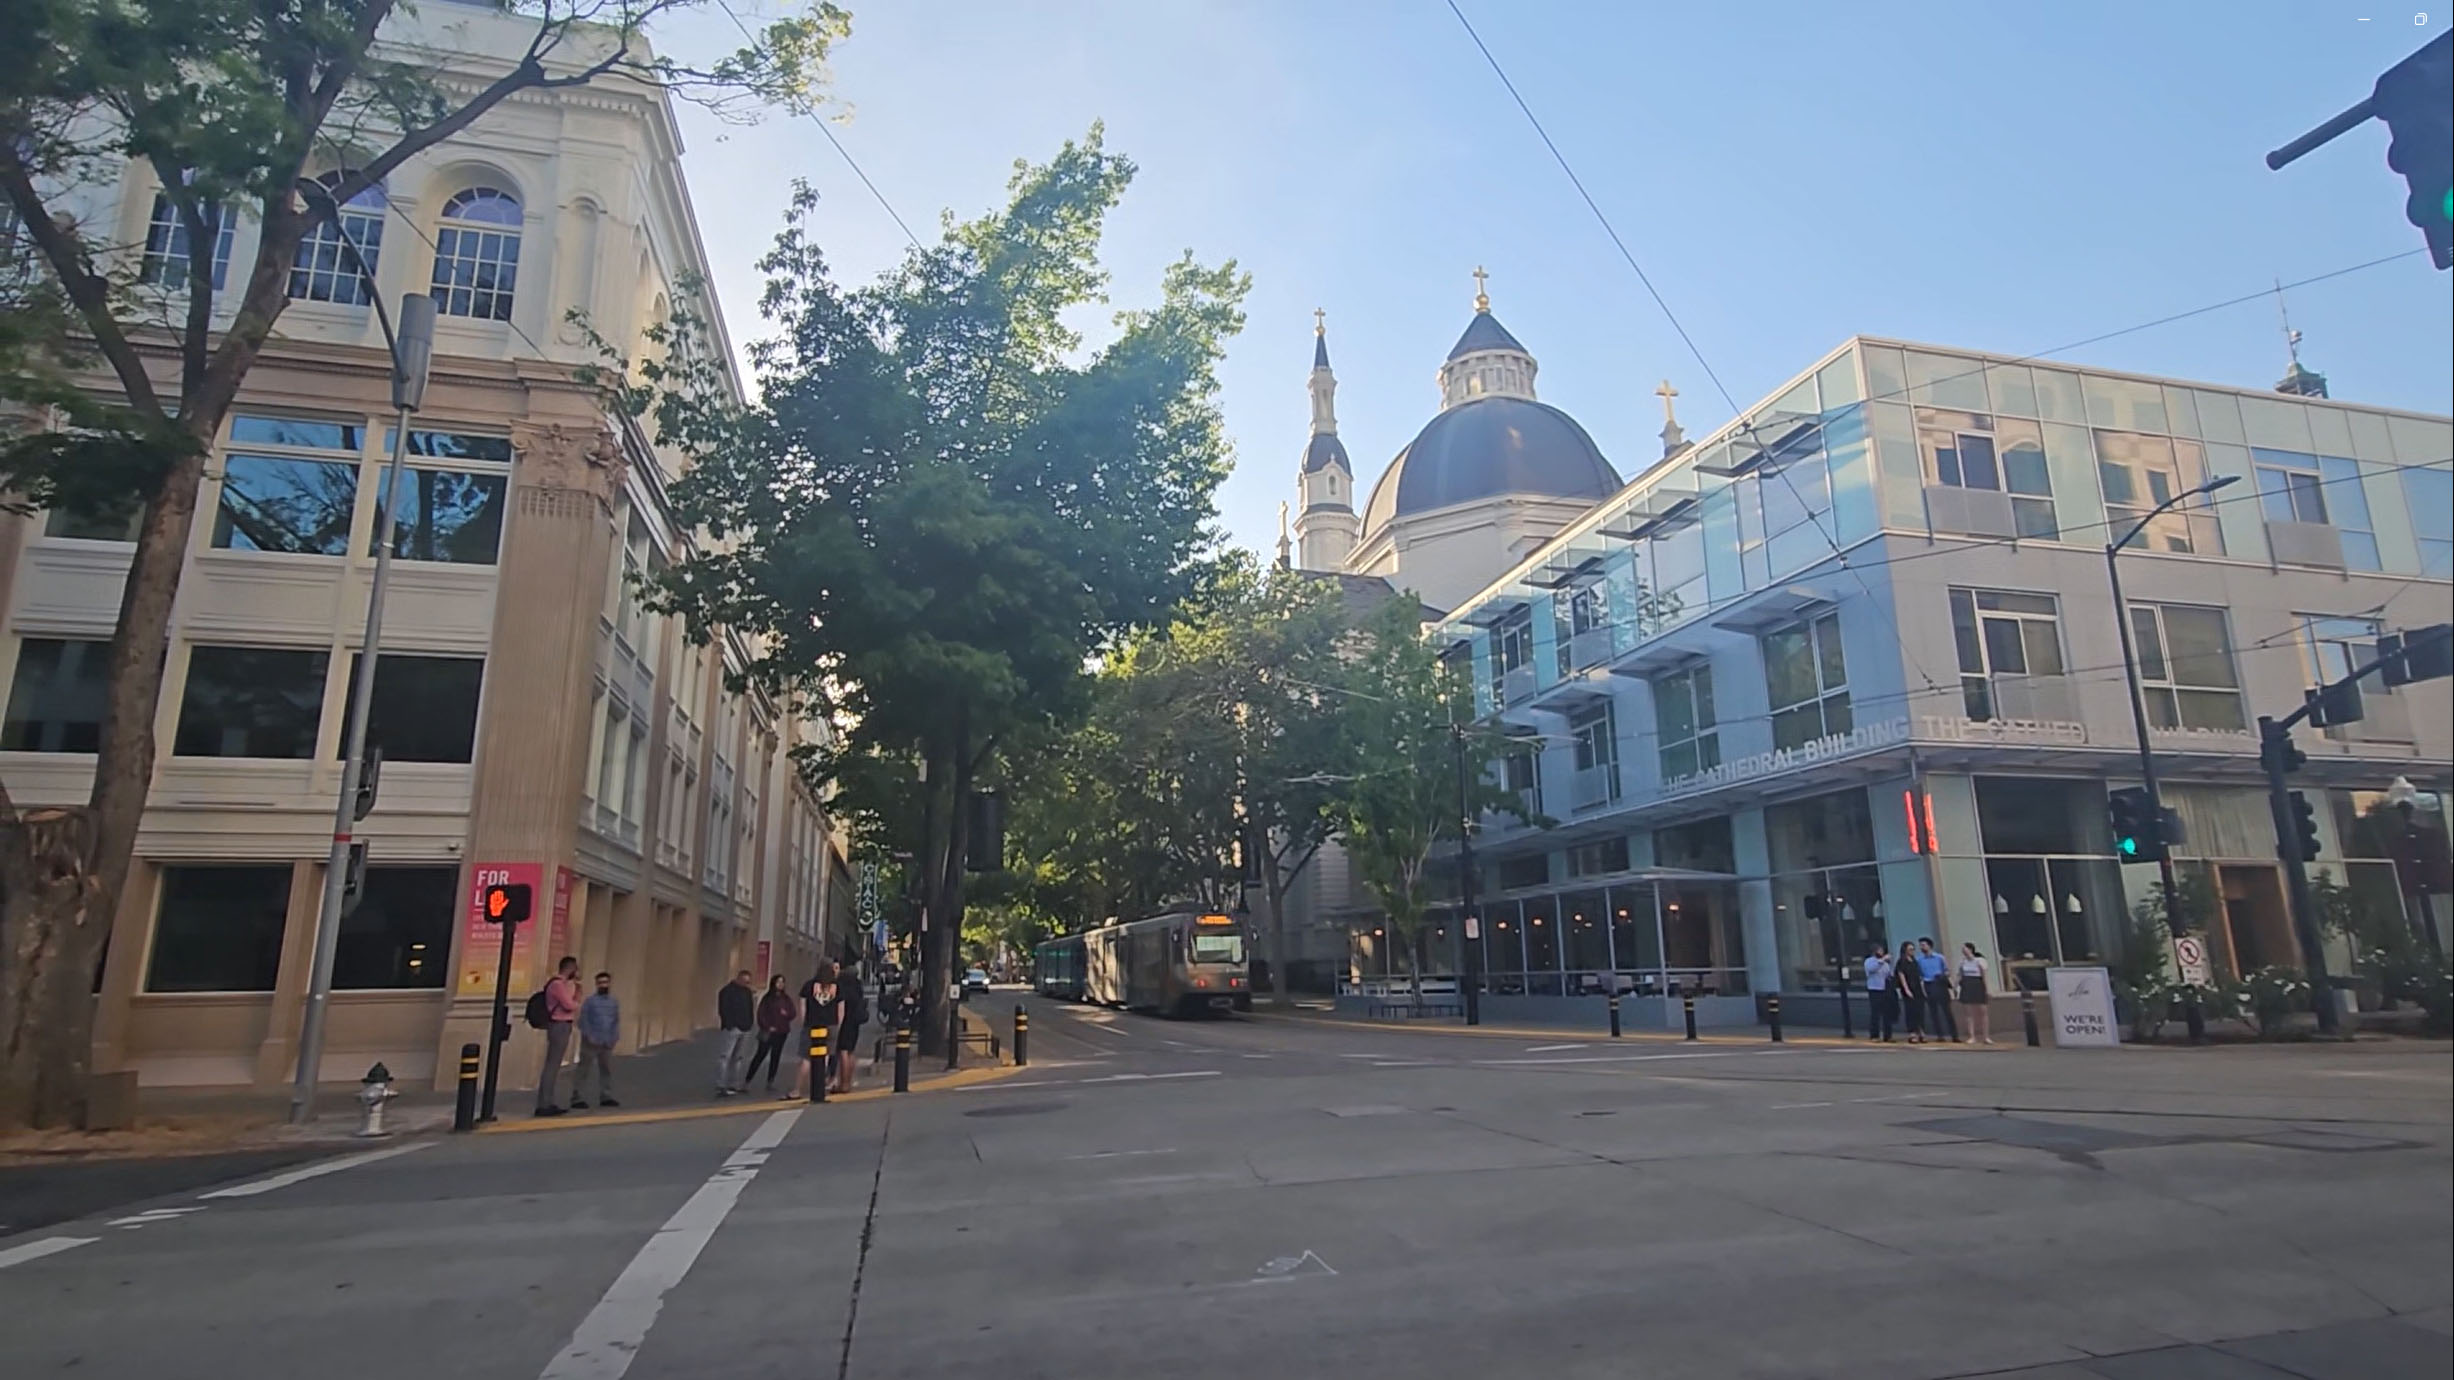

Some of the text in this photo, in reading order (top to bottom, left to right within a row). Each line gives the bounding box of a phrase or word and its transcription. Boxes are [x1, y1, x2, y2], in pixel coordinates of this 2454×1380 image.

[1922, 715, 1972, 740] THE
[1803, 715, 1909, 762] BUILDING
[476, 869, 510, 887] FOR
[2063, 1014, 2104, 1025] WE'RE
[2065, 1024, 2106, 1035] OPEN!
